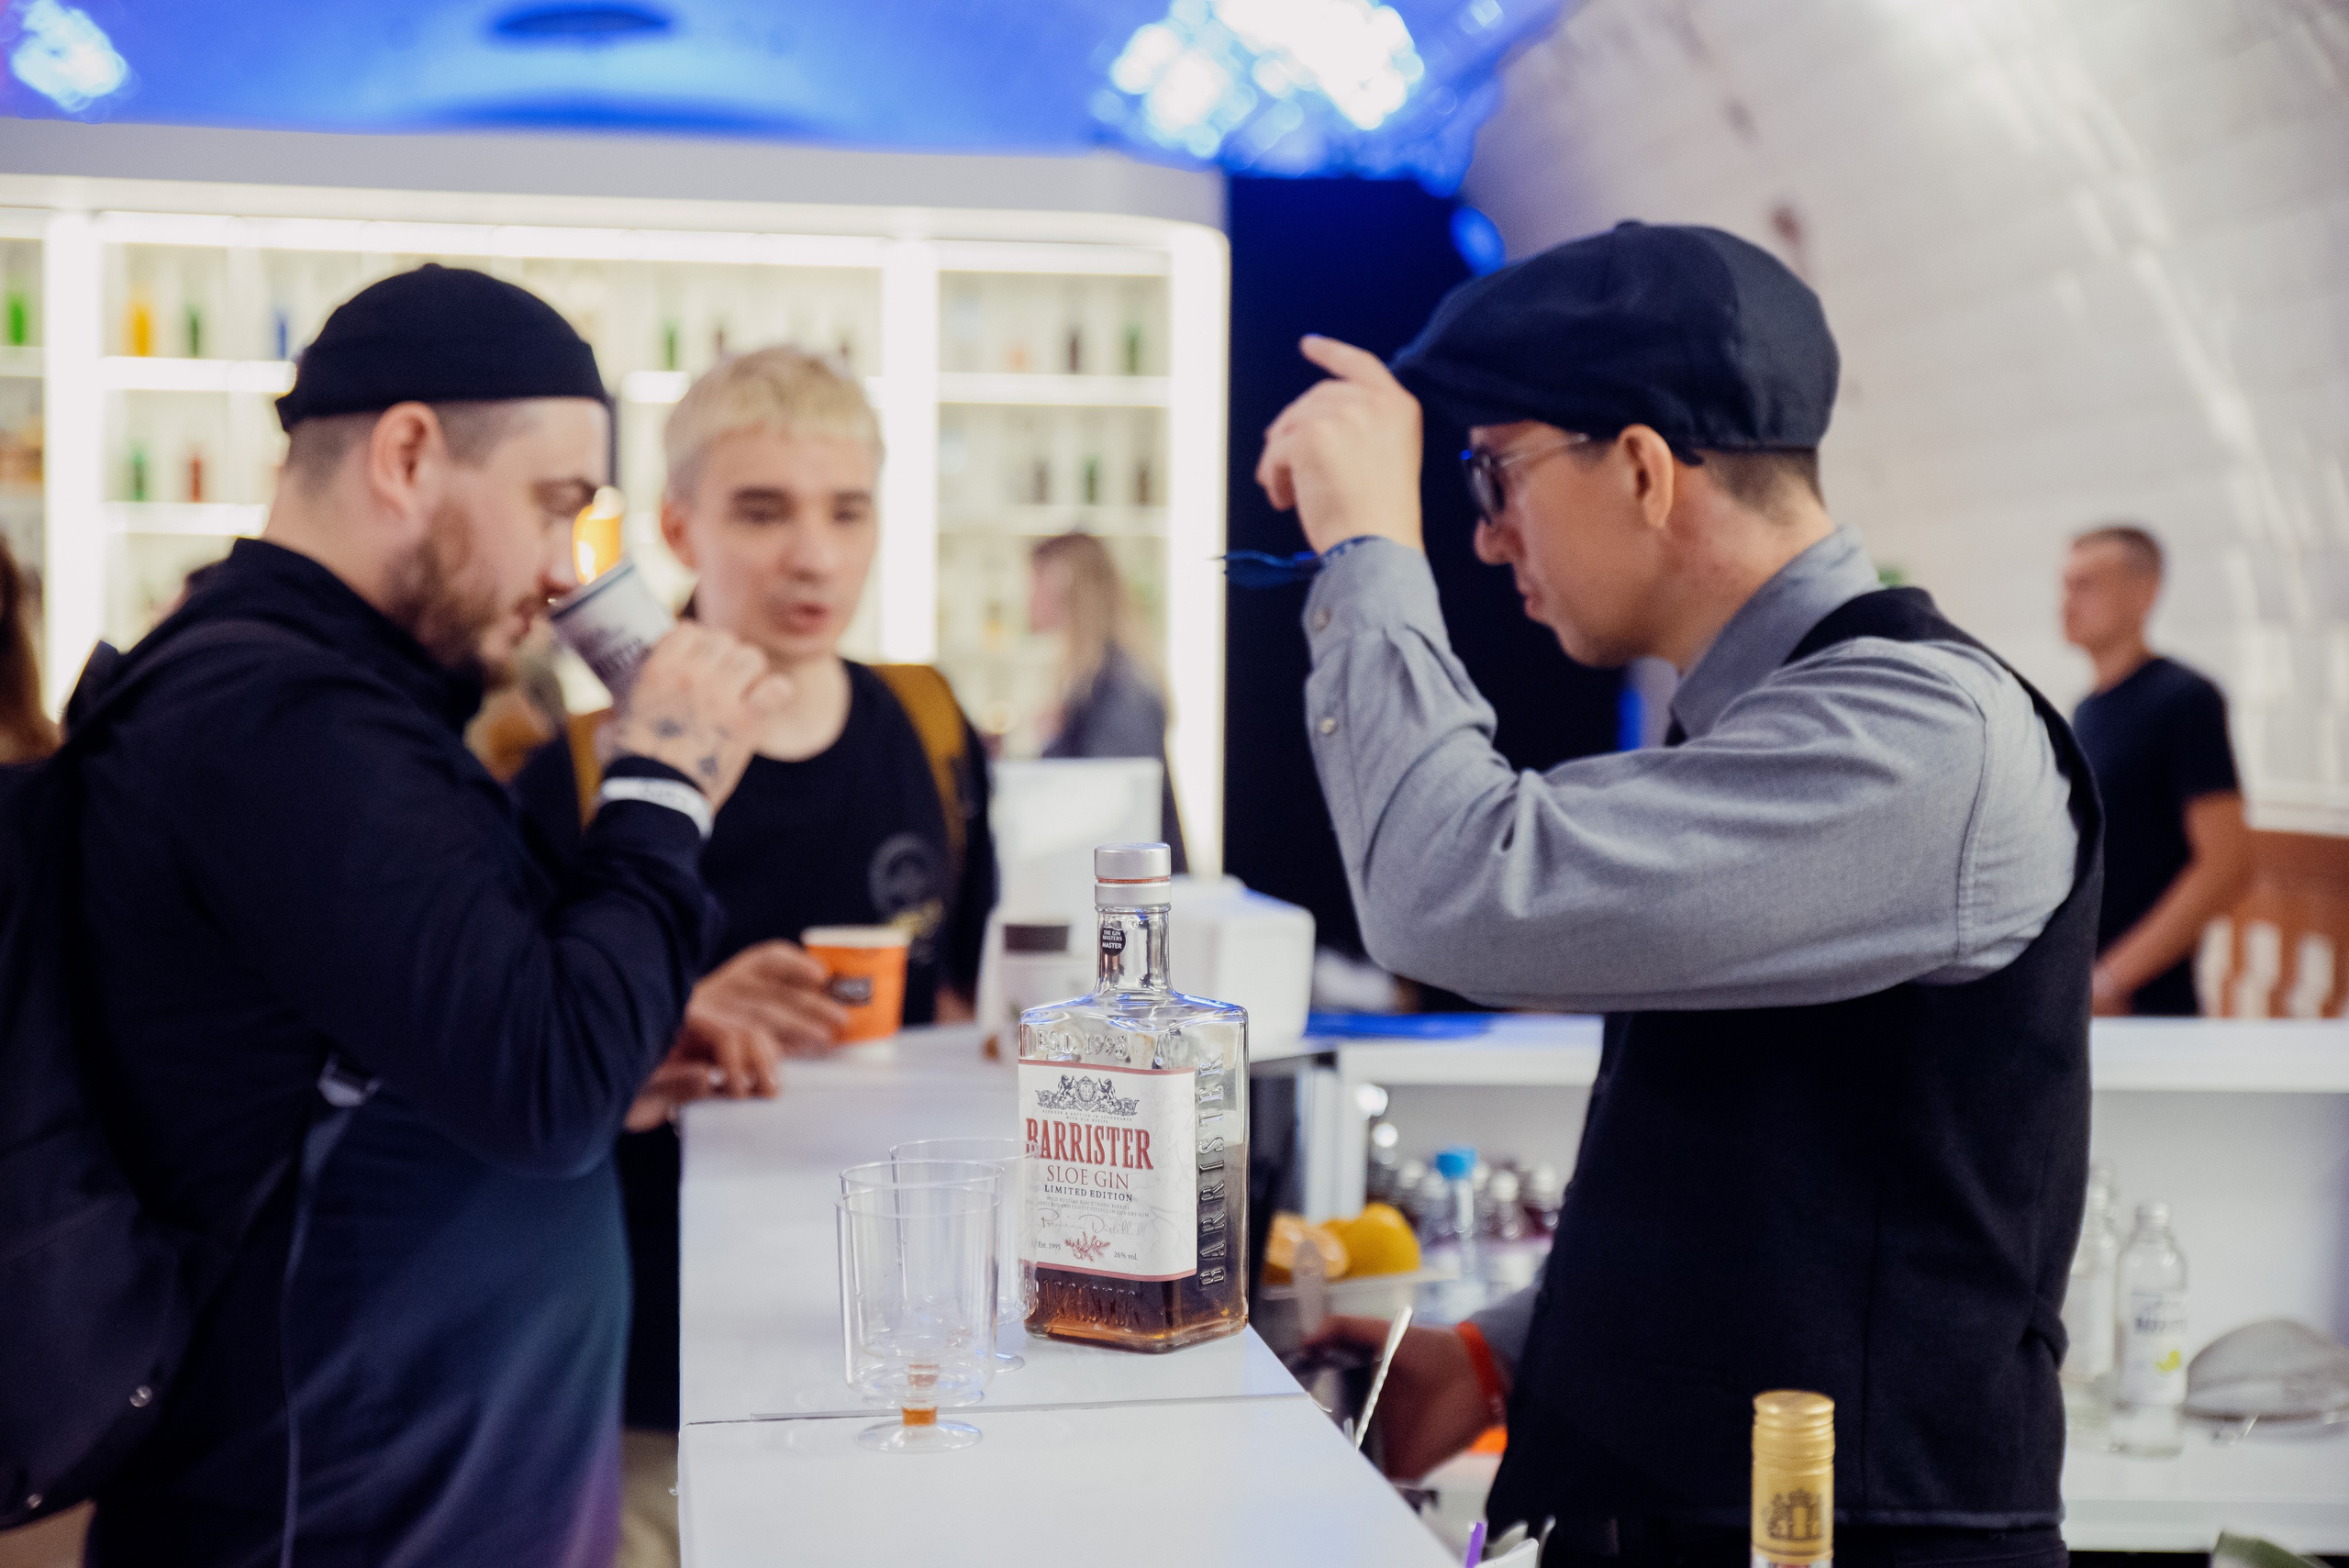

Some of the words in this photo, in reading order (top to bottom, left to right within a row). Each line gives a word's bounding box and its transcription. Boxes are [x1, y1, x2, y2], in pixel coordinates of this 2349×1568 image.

[1037, 1029, 1079, 1055] EST.
[1084, 1033, 1129, 1060] 1995
[1025, 1118, 1154, 1170] BARRISTER
[1047, 1164, 1089, 1186] SLOE
[1094, 1170, 1130, 1191] GIN
[1198, 1055, 1226, 1286] BARRISTER
[1044, 1184, 1087, 1197] LIMITED
[1090, 1190, 1133, 1203] EDITION
[1038, 1240, 1048, 1249] Est.
[1049, 1241, 1062, 1251] 1995
[1113, 1251, 1127, 1260] 26%
[1127, 1252, 1139, 1261] vol.
